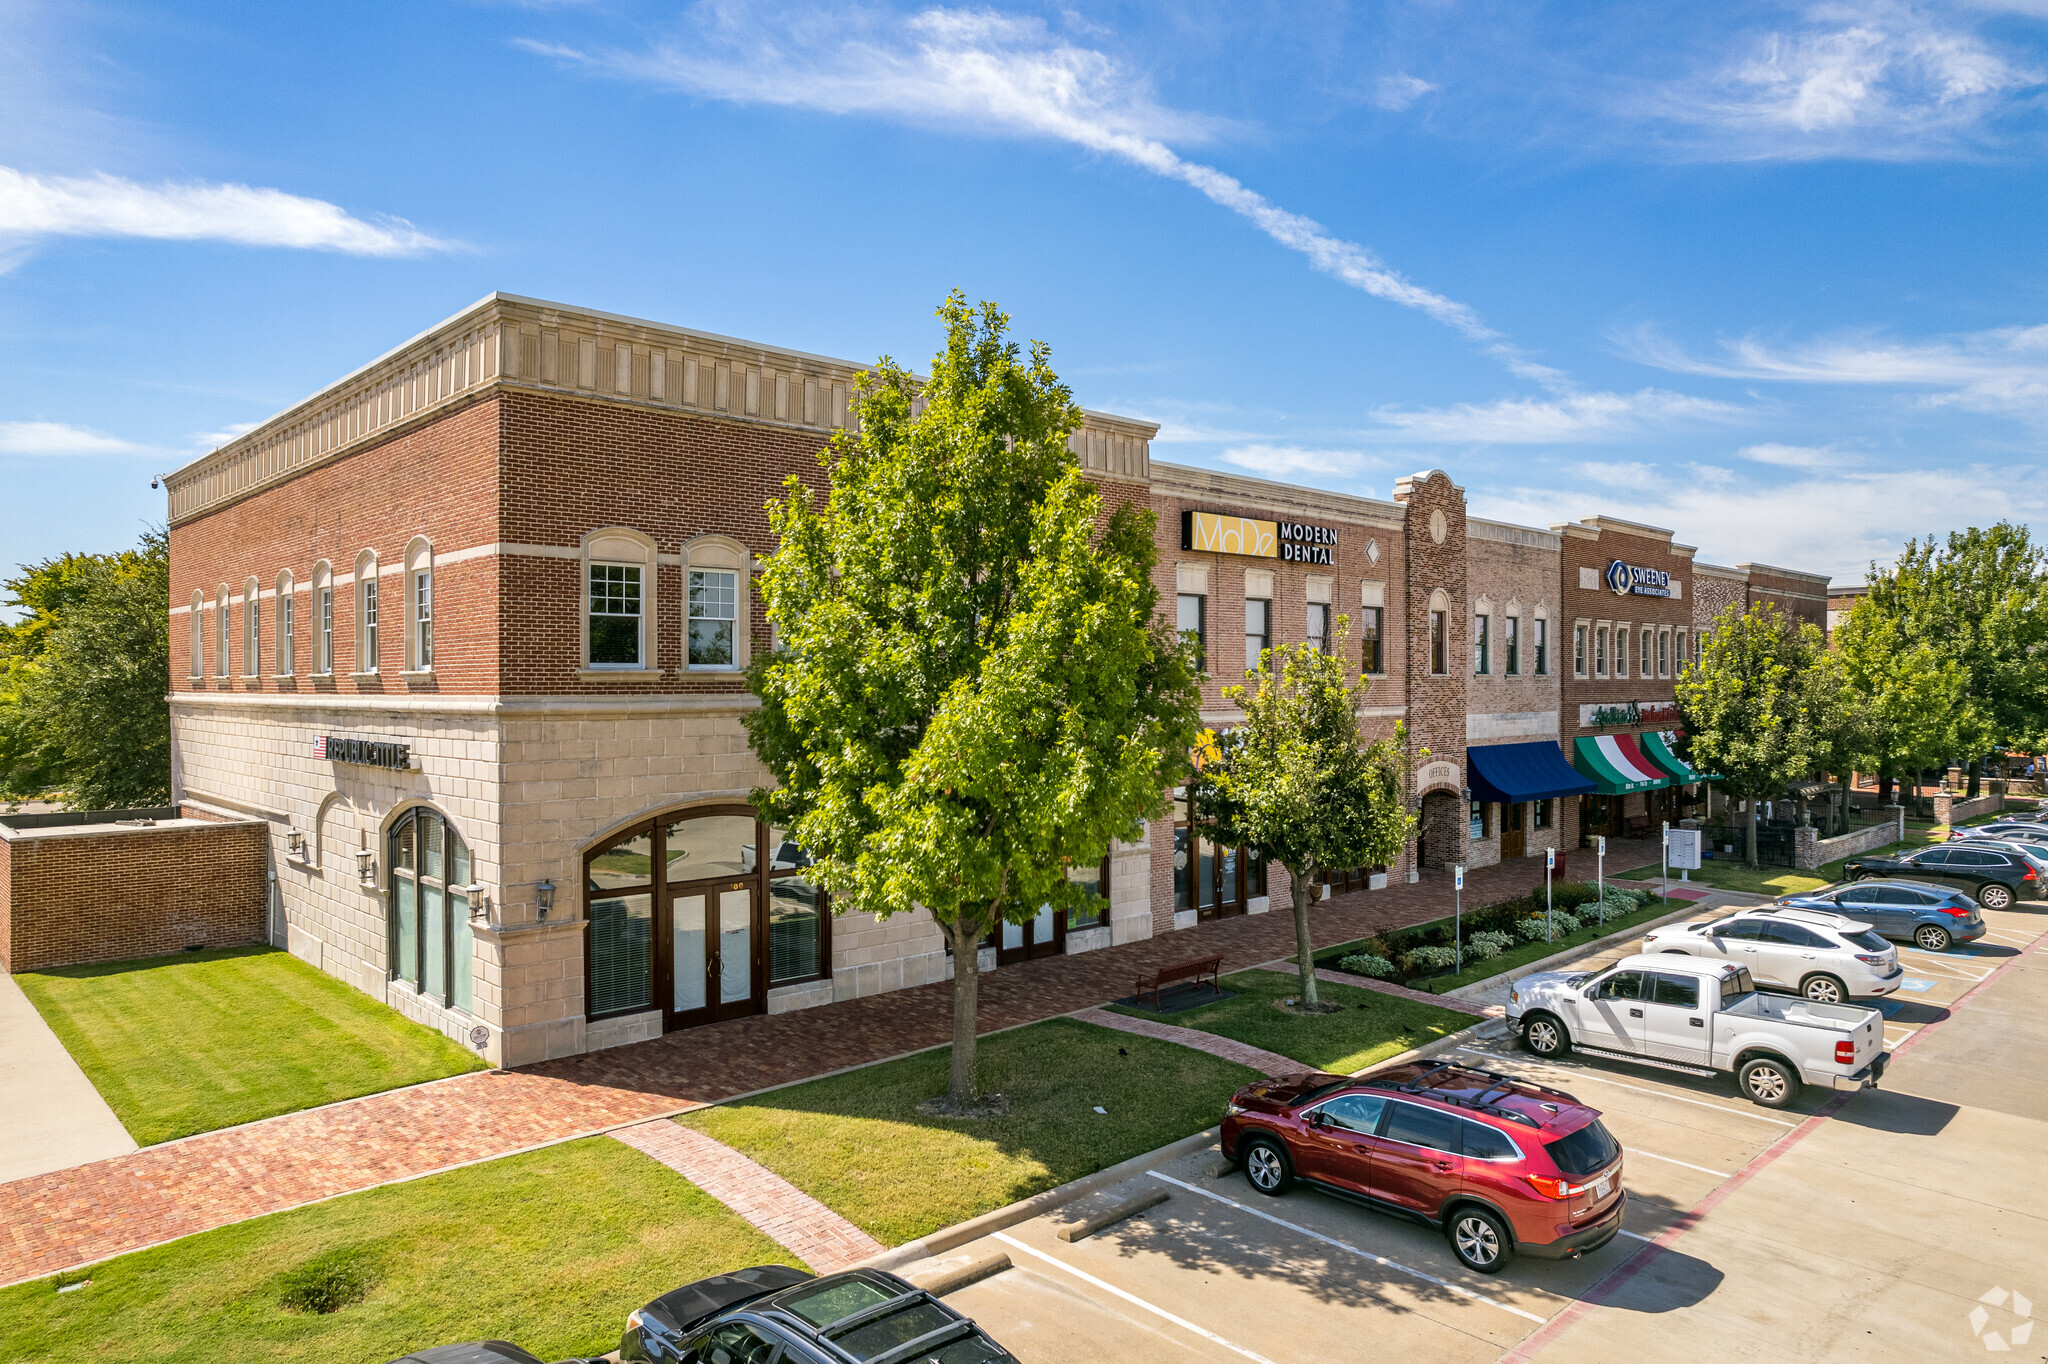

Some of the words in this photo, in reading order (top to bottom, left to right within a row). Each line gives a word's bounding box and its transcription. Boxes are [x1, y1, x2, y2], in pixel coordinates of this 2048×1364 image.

[1194, 511, 1275, 558] MoDe
[1281, 522, 1338, 545] MODERN
[1284, 544, 1335, 565] DENTAL
[1633, 567, 1671, 586] SWEENEY
[1634, 586, 1644, 594] EYE
[1644, 587, 1669, 597] ASSOCIATES
[326, 737, 372, 765] REPUBLIC
[374, 741, 404, 770] TITLE
[1428, 767, 1450, 778] OFFICES
